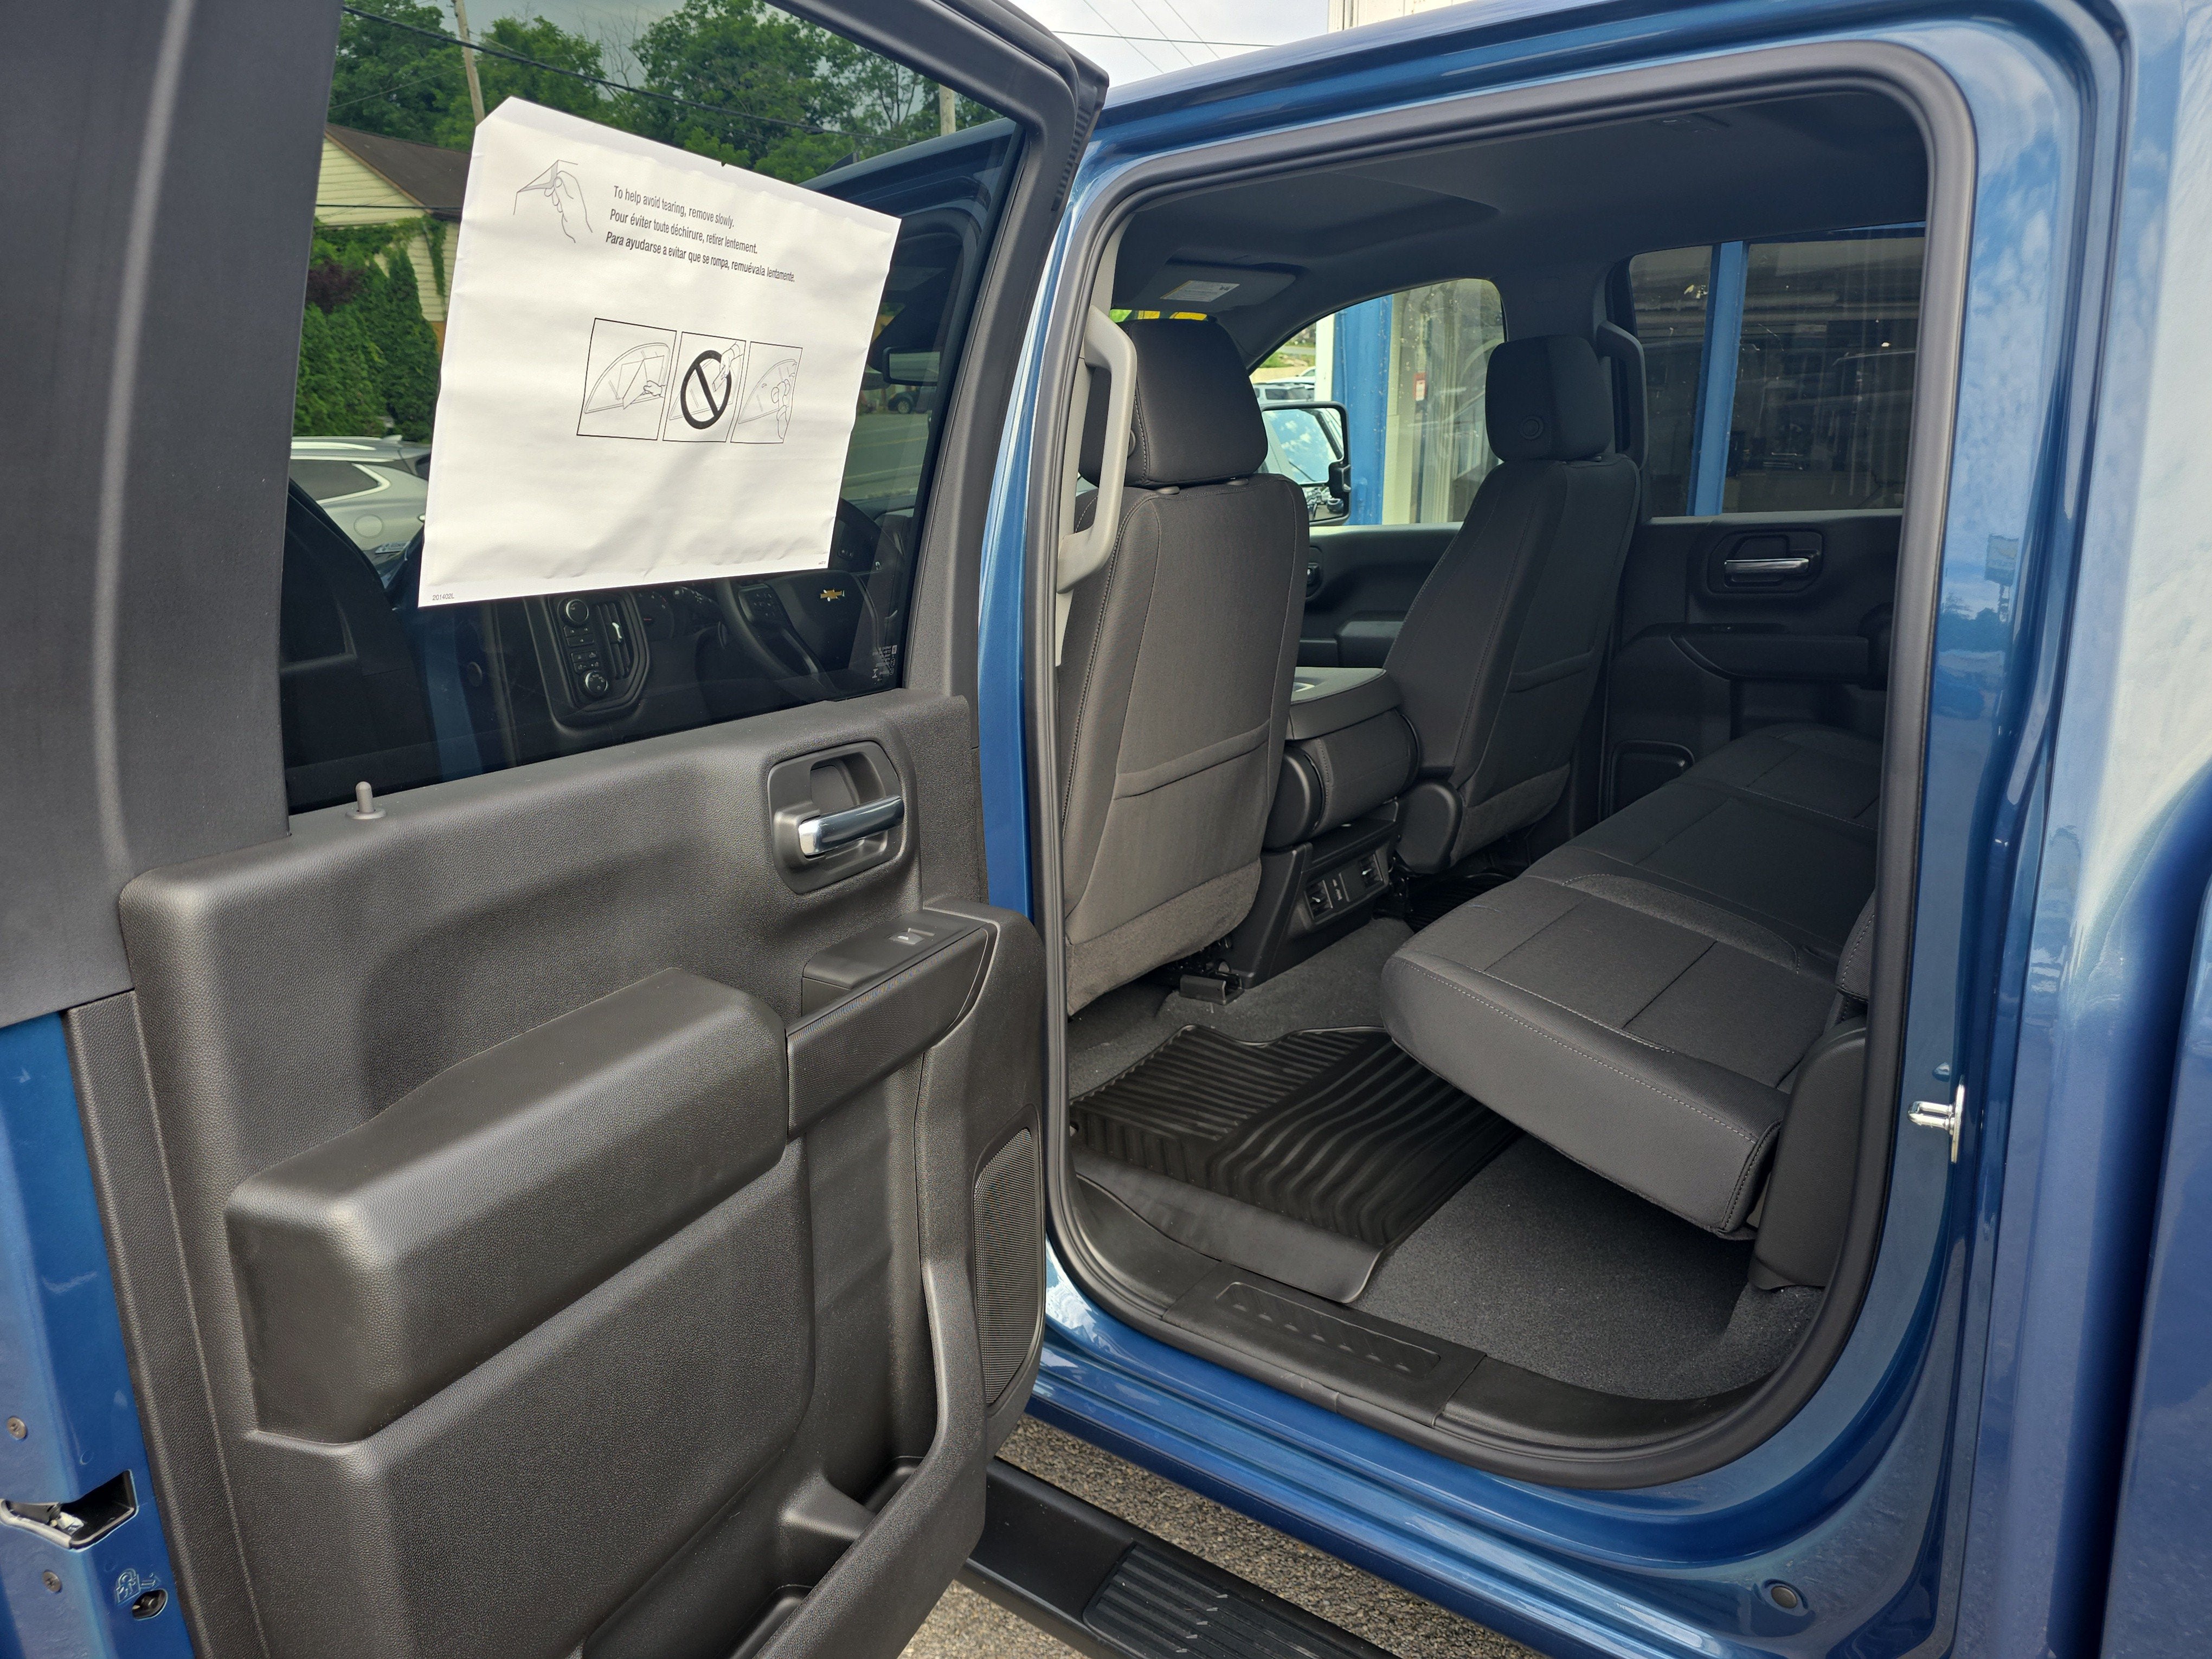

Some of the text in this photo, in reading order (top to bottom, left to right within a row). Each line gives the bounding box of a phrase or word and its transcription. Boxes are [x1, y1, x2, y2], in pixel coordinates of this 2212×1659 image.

[614, 185, 735, 229] To help avoid tearing, remove slowly.
[610, 208, 757, 254] Pour éviter toute déchirure, retirer lentement.
[606, 231, 795, 282] Para ayudarse a evitar que se rompa, remuévala lentamente.
